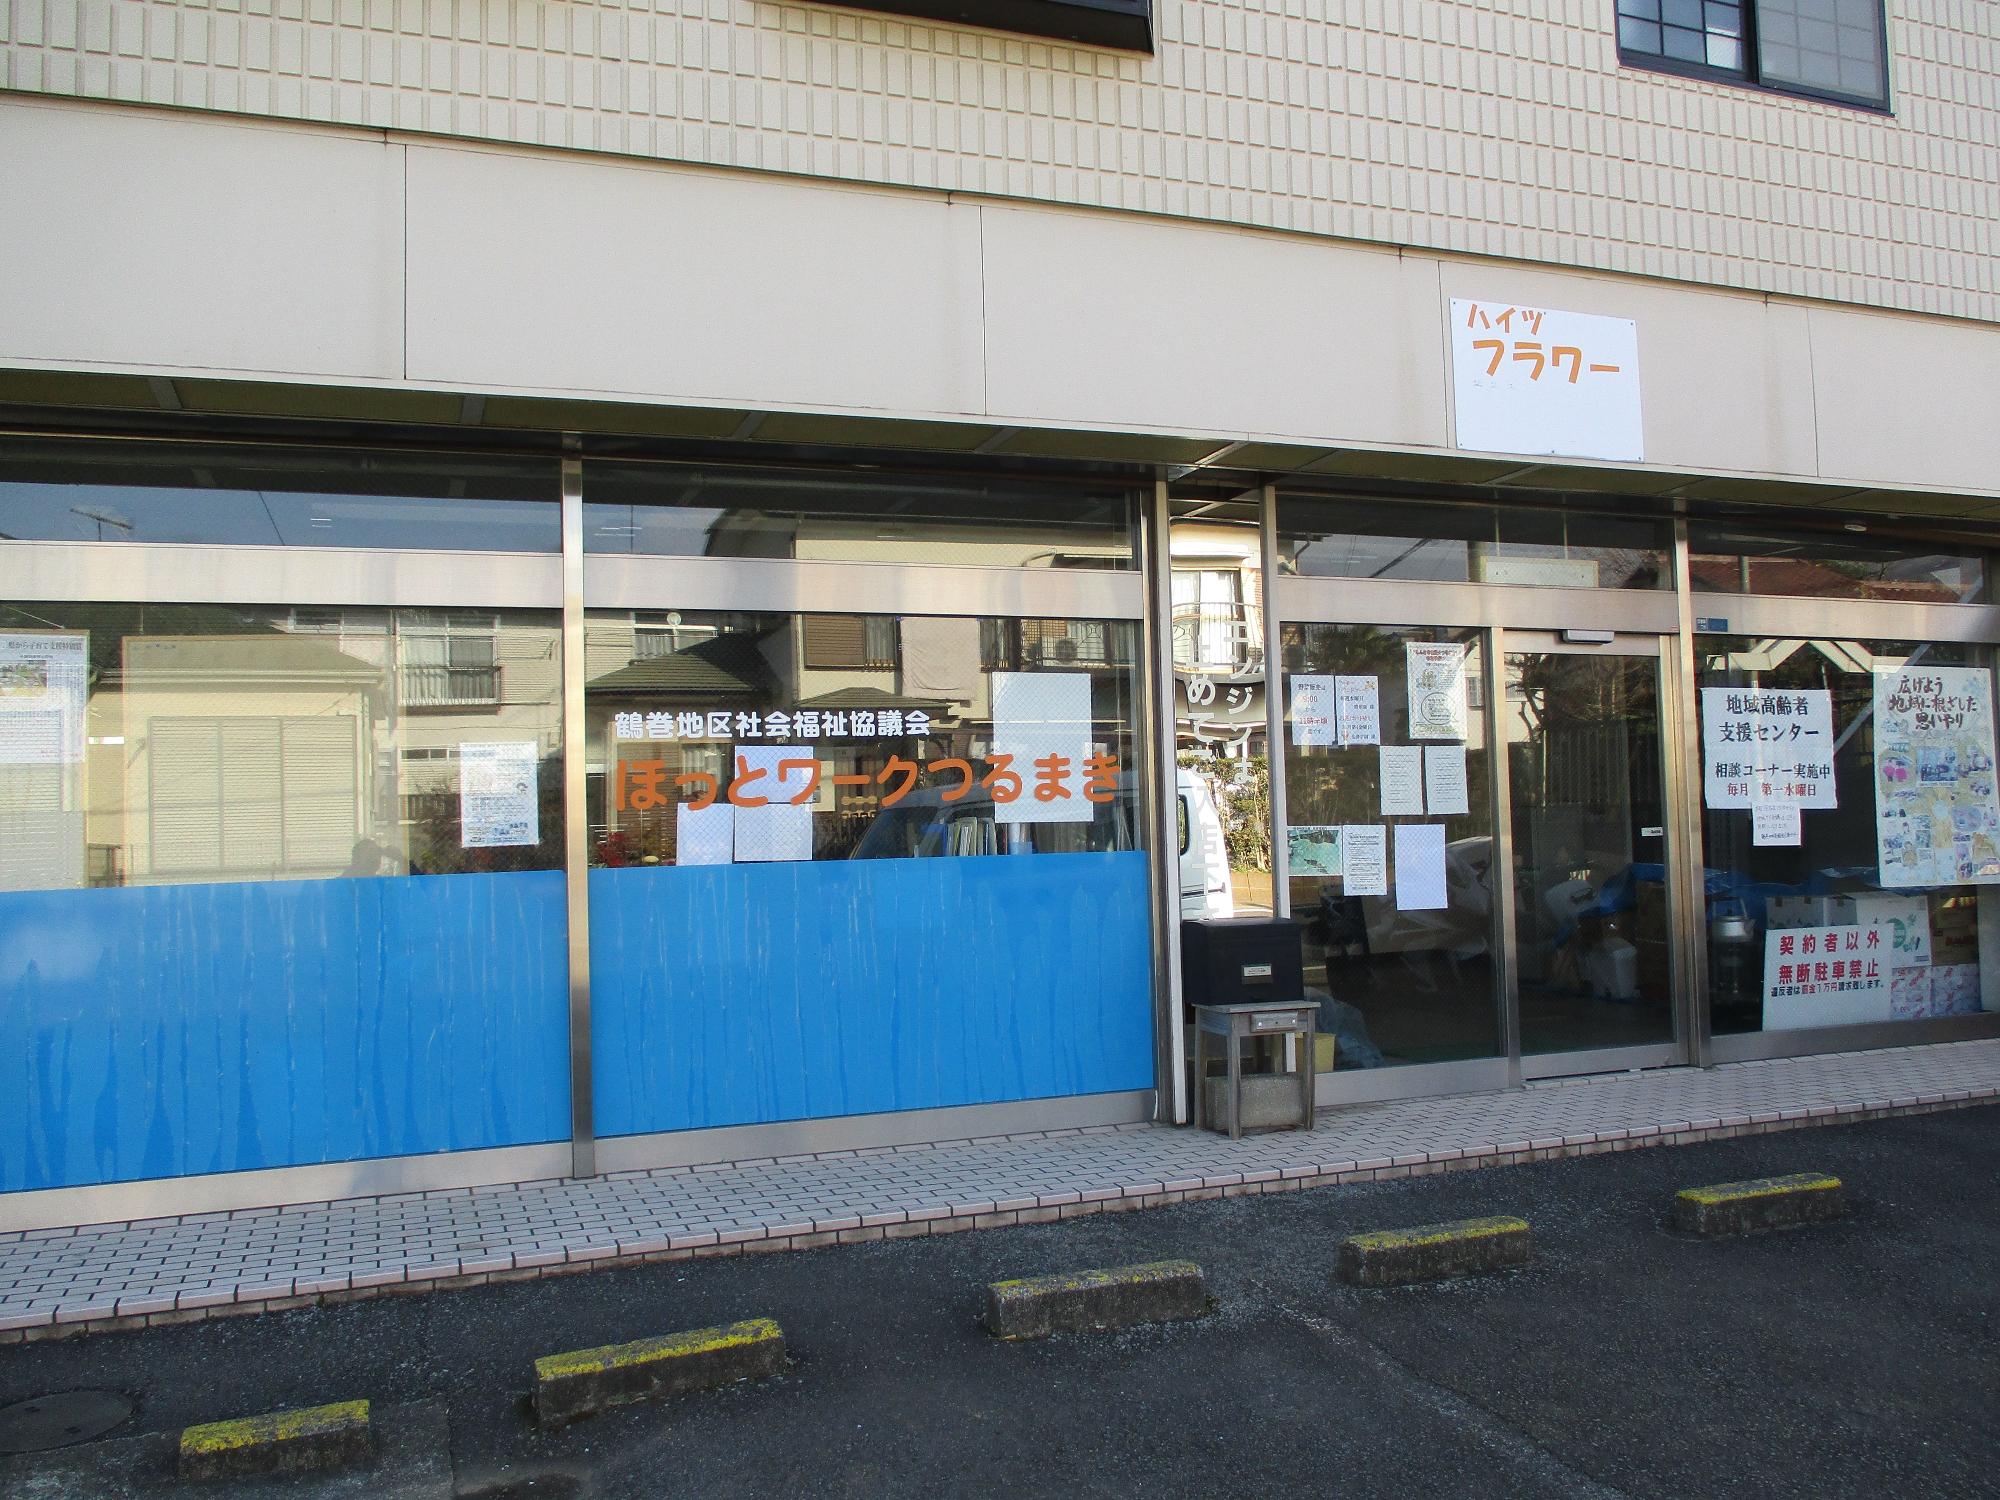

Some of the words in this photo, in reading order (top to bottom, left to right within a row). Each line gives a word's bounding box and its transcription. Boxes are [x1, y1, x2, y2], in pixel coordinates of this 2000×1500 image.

[1467, 303, 1543, 336] ハイツ
[1472, 339, 1620, 384] フラワー
[1897, 674, 1943, 696] 広げよう
[1726, 694, 1809, 716] 地域高齢者
[1888, 694, 1978, 714] 地域に根ざした
[614, 710, 931, 740] 鶴巻地区社会福祉協議会
[1915, 711, 1963, 730] 思いやり
[1718, 721, 1819, 743] 支援センター
[1715, 762, 1831, 779] 相談コーナー実施中
[615, 752, 1122, 812] ほっとワークつるまき
[1727, 783, 1749, 797] 毎月
[1761, 783, 1816, 797] 第一水曜日
[1779, 929, 1881, 956] 契約者以外
[1778, 958, 1880, 984] 無断駐車禁止
